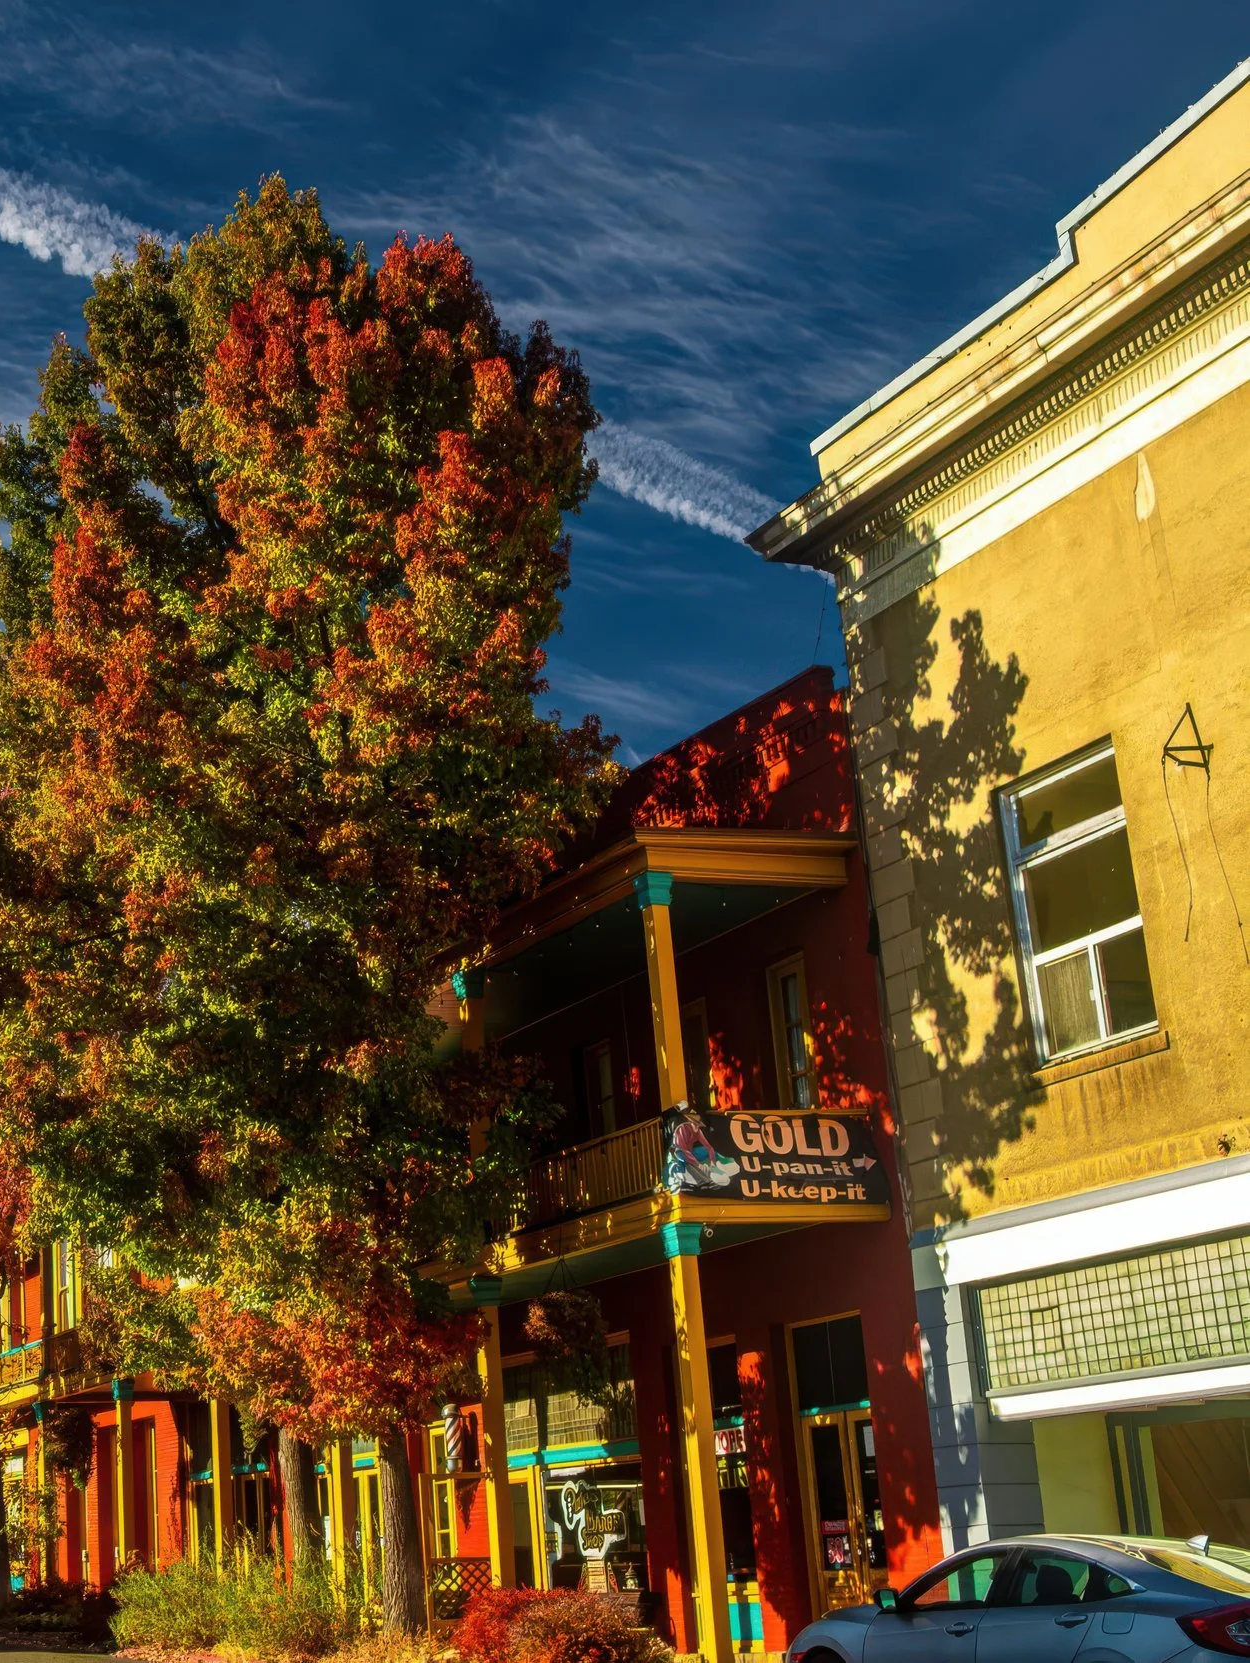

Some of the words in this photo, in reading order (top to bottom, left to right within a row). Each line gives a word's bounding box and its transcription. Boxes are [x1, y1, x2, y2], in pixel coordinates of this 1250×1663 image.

[730, 1114, 850, 1157] GOLD
[741, 1156, 854, 1177] U-pan-it
[740, 1179, 867, 1202] U-keep-it
